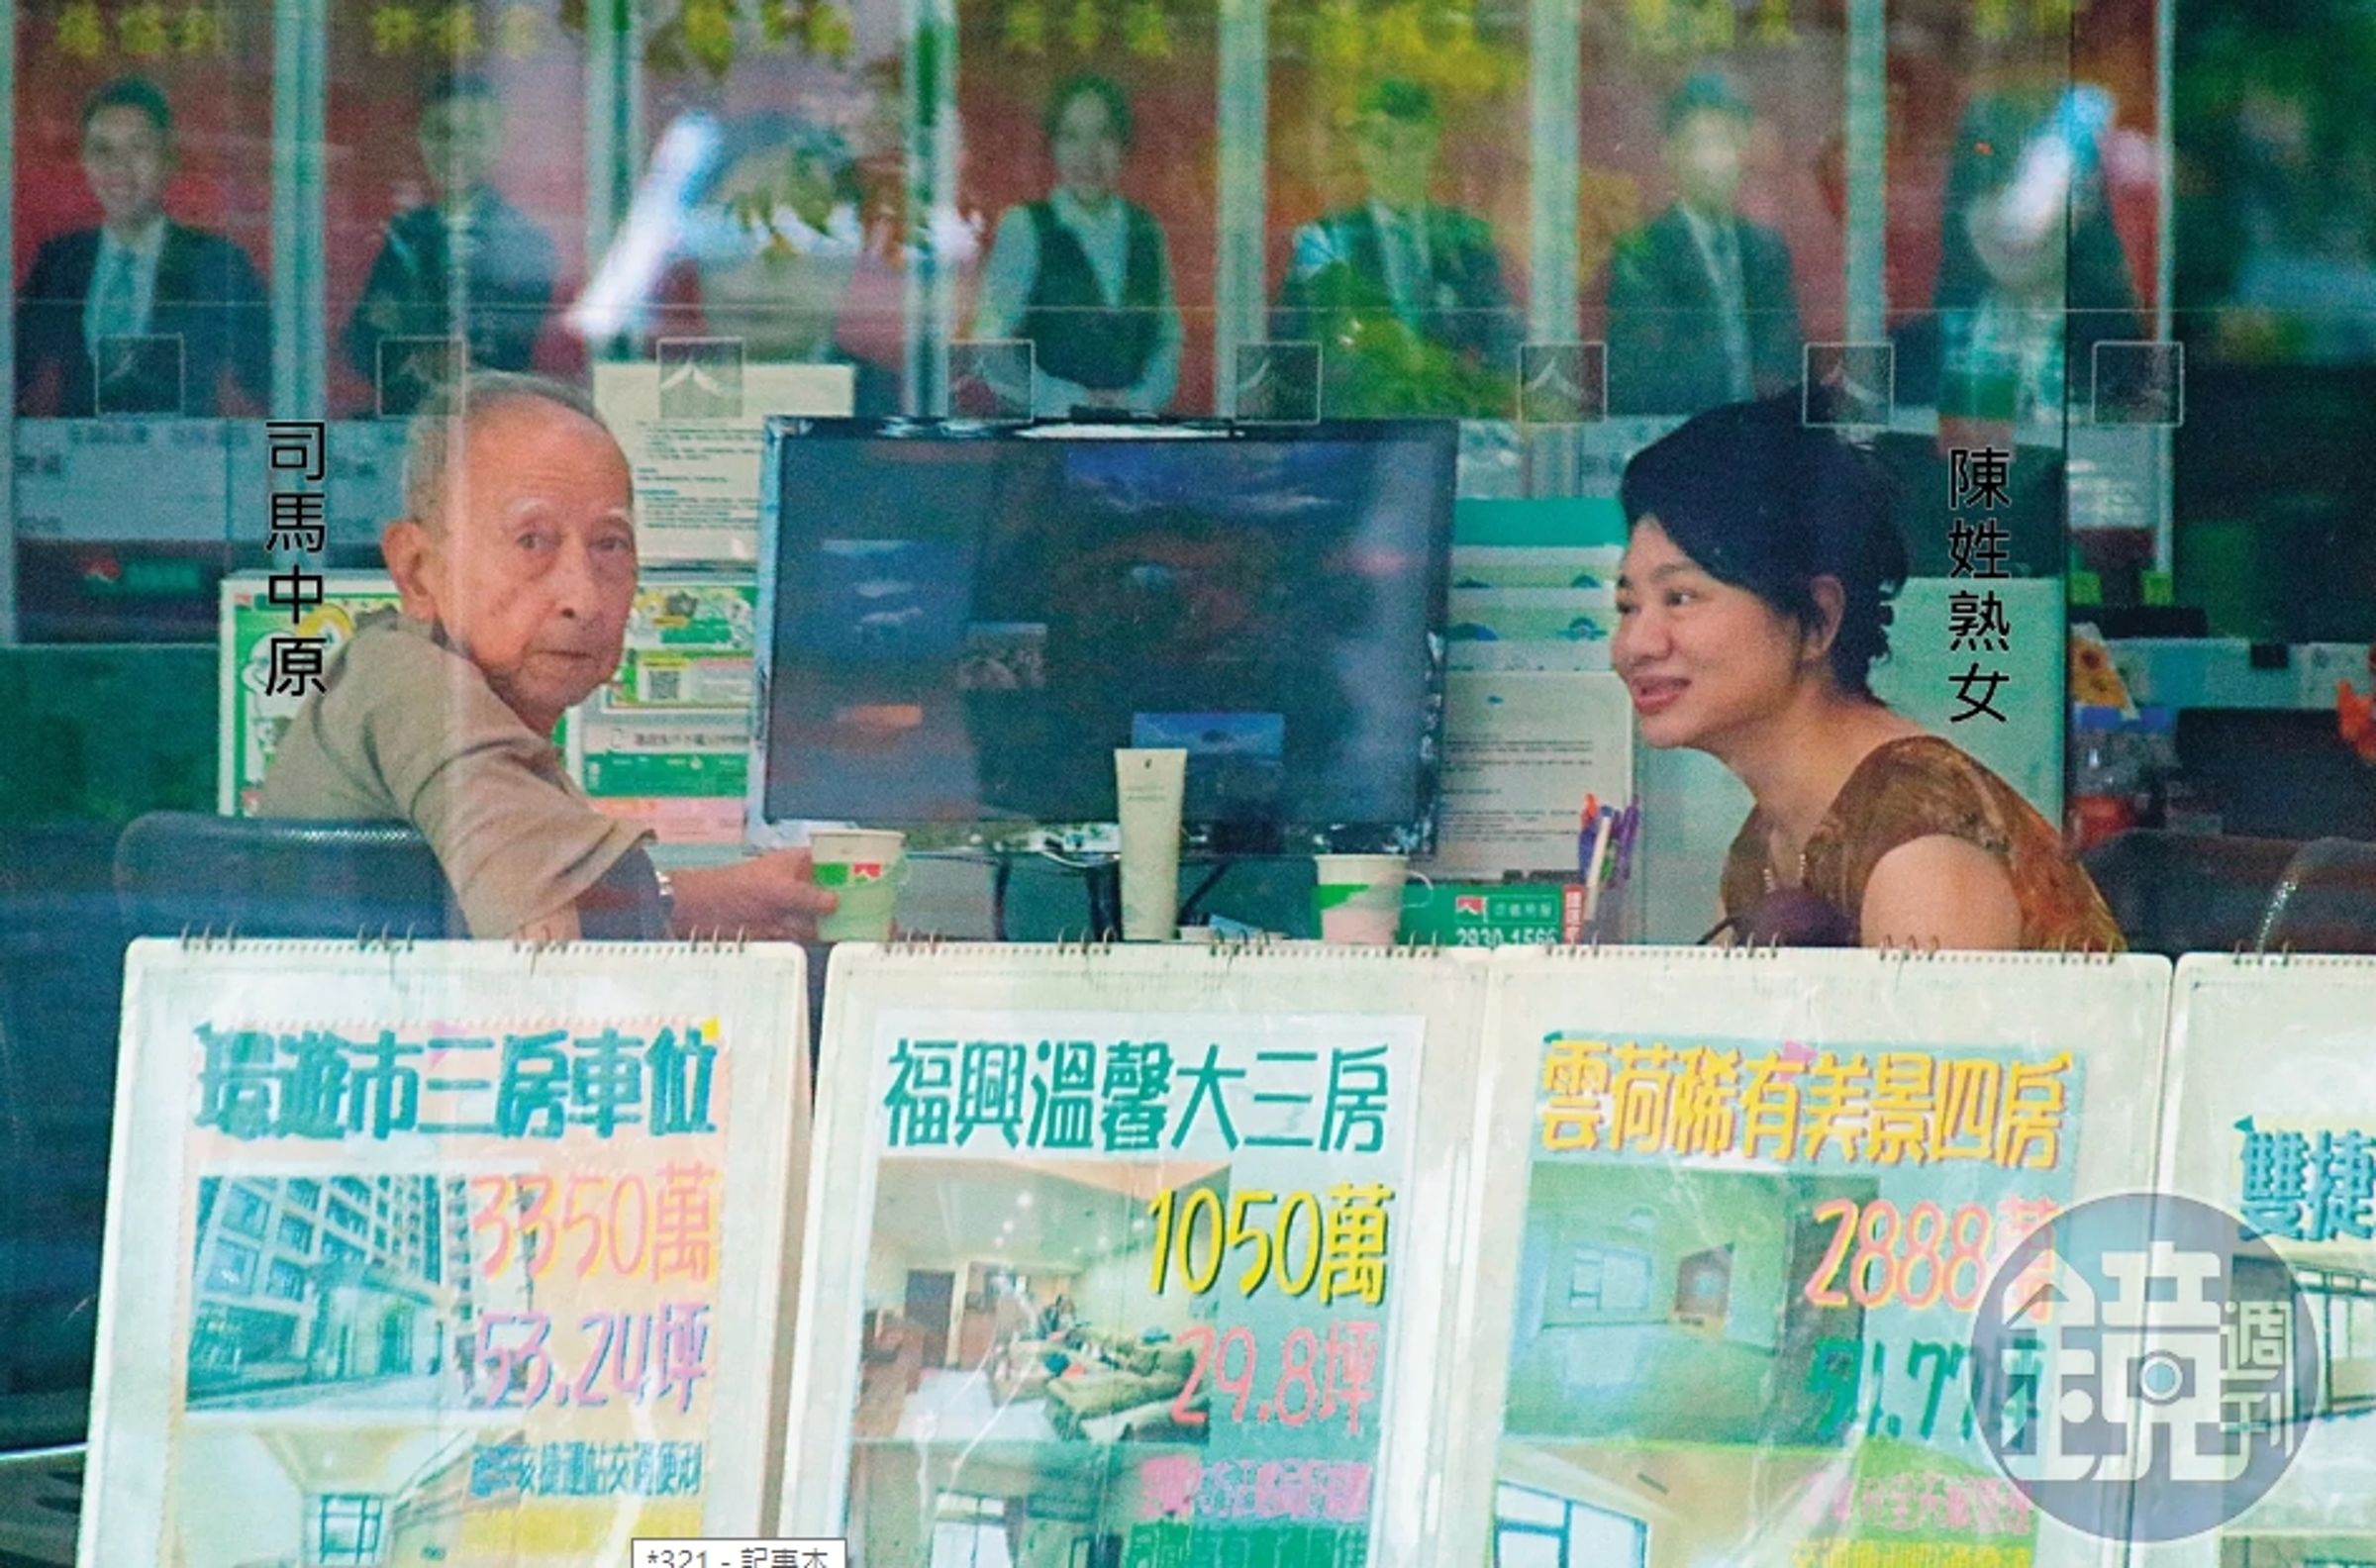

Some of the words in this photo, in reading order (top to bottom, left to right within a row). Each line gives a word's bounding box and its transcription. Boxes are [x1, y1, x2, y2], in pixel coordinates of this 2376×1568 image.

[883, 1037, 1390, 1152] 福興溫馨大三房
[1540, 1039, 2073, 1170] 雲荷稀有美景四房
[470, 1160, 723, 1284] 3350萬
[1146, 1183, 1395, 1307] 1050萬
[475, 1301, 711, 1413] 53.24坪
[1170, 1321, 1380, 1435] 29.8坪
